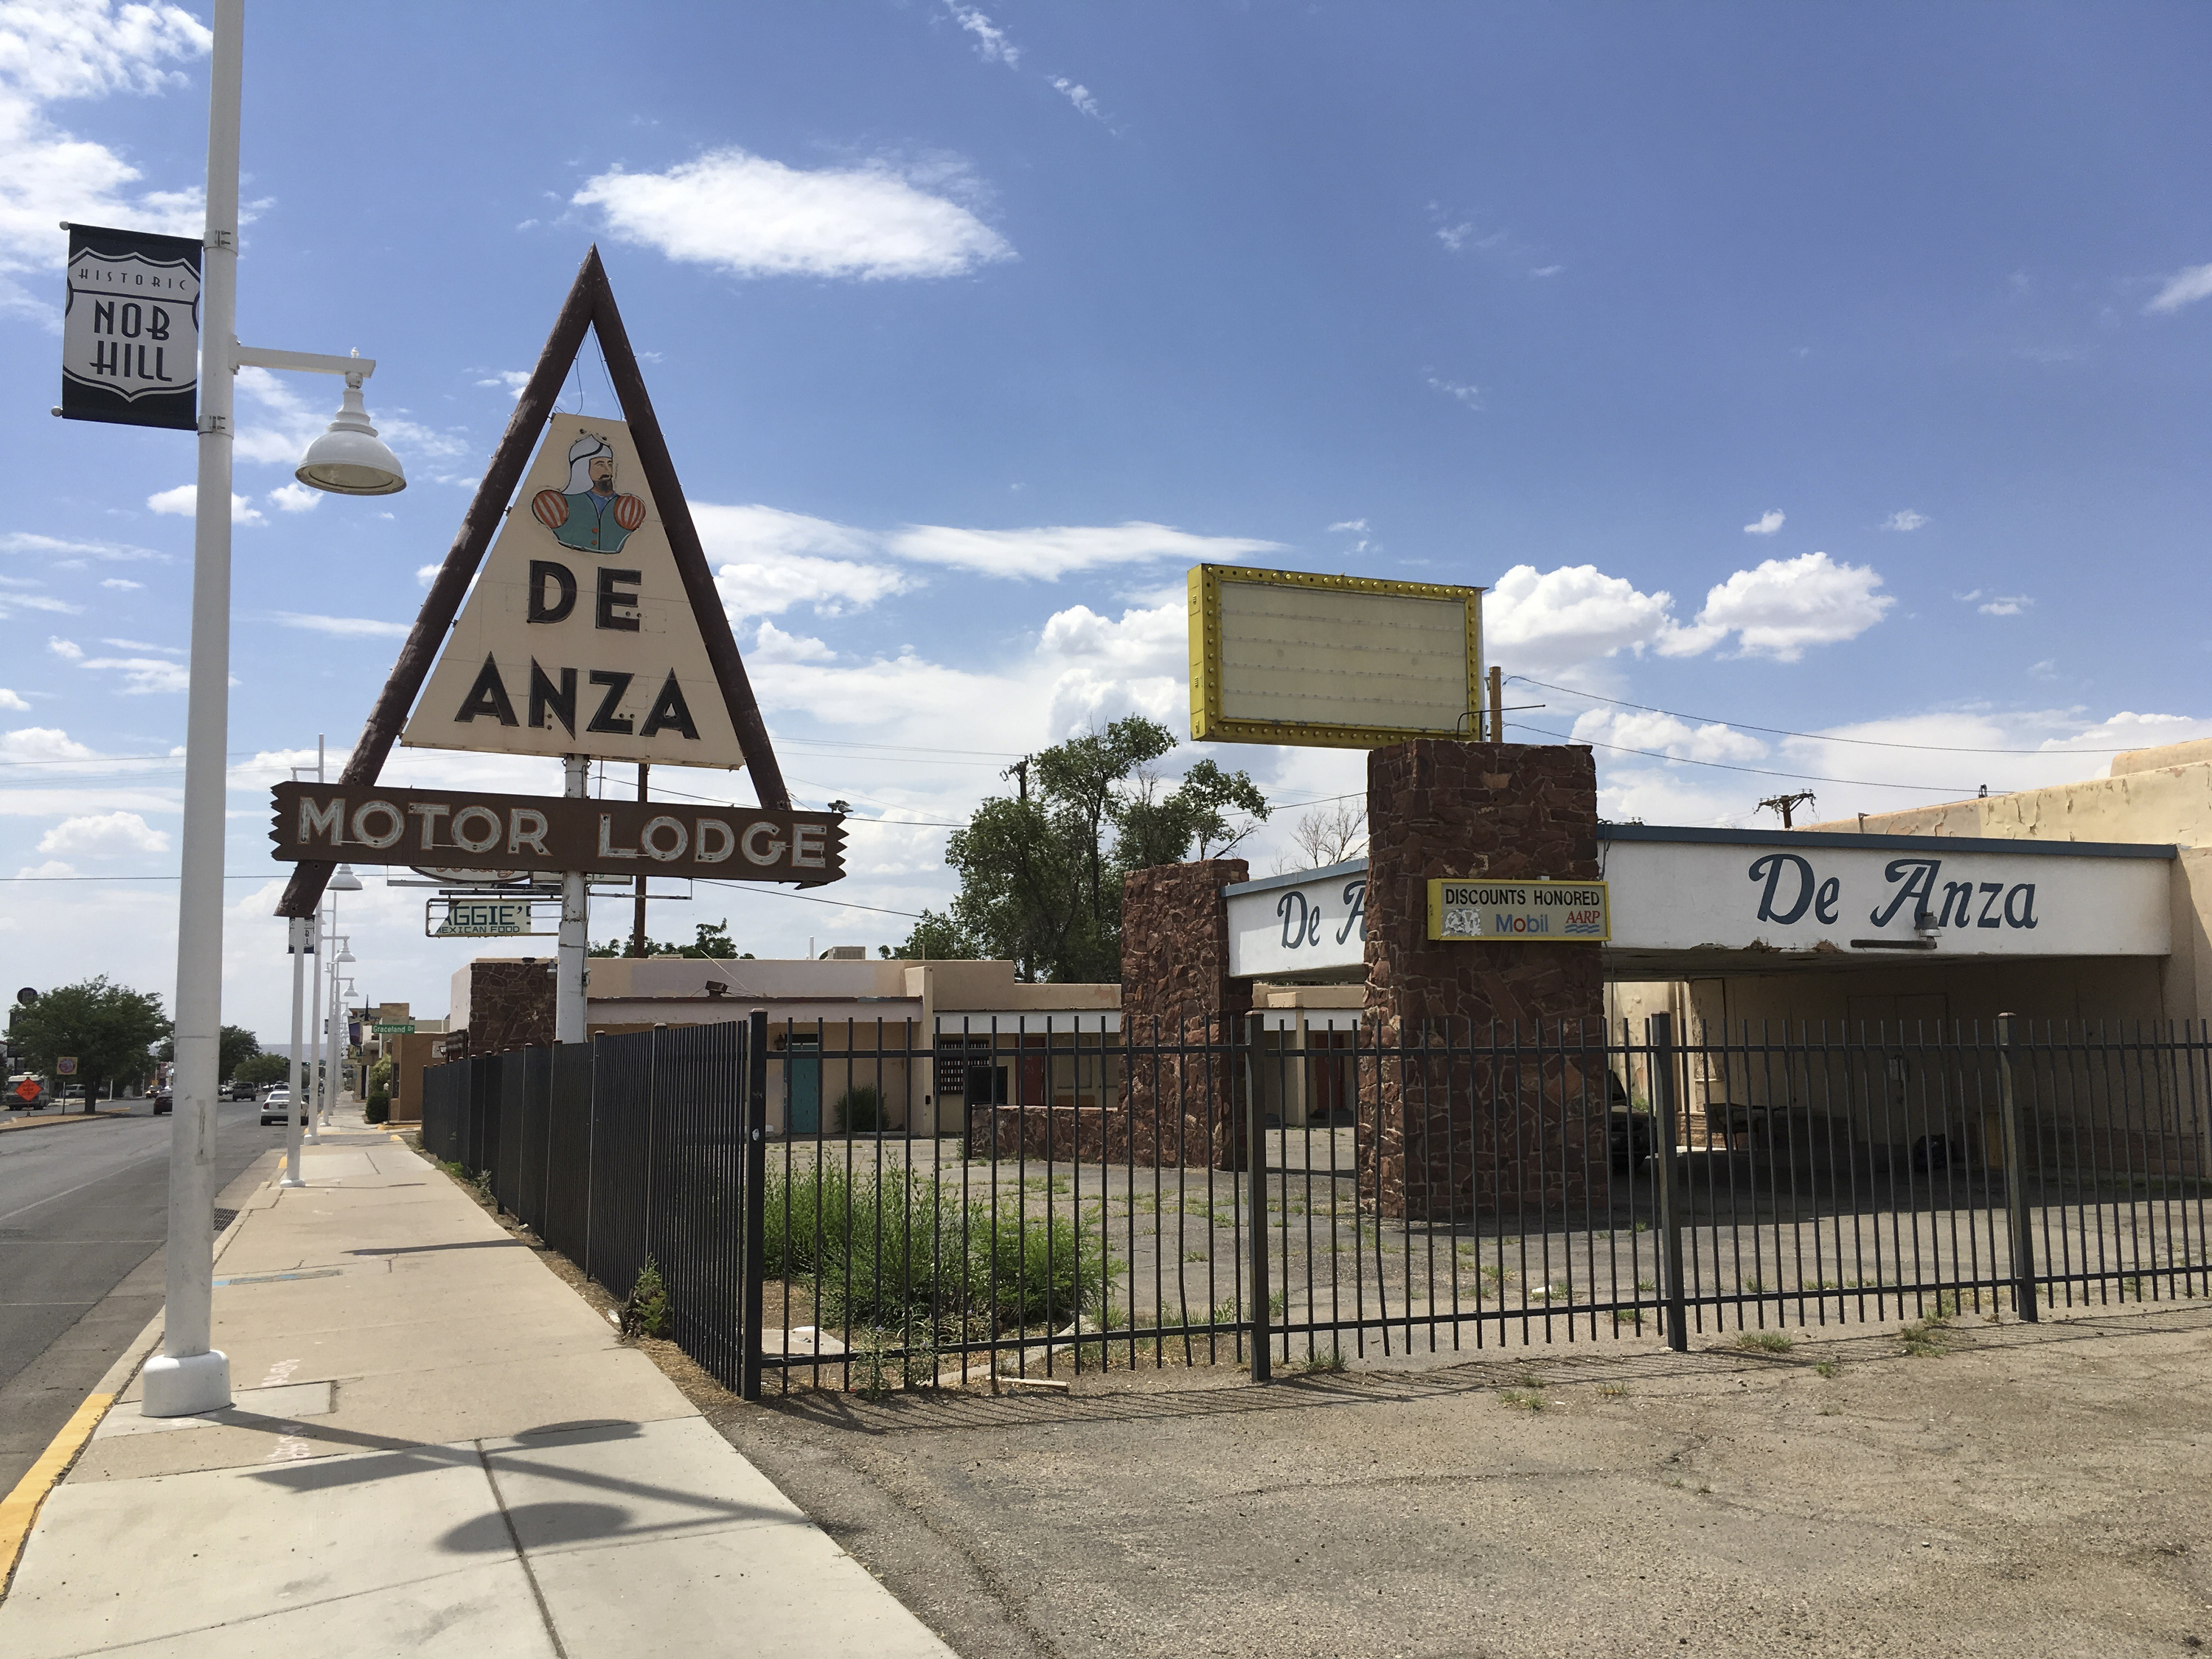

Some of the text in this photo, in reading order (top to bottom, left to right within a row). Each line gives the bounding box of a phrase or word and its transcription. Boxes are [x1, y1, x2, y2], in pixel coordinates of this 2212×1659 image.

[79, 268, 186, 291] HISTORIC
[94, 299, 170, 341] NOB
[88, 341, 173, 382] HILL
[527, 560, 642, 633] DE
[453, 651, 701, 740] ANZA
[297, 796, 827, 869] MOTOR LODGE
[1445, 888, 1600, 906] DISCOUNTS HONORED
[1748, 854, 2038, 929] De Anza
[1277, 891, 1321, 949] De
[1495, 911, 1601, 933] Mobil AARP
